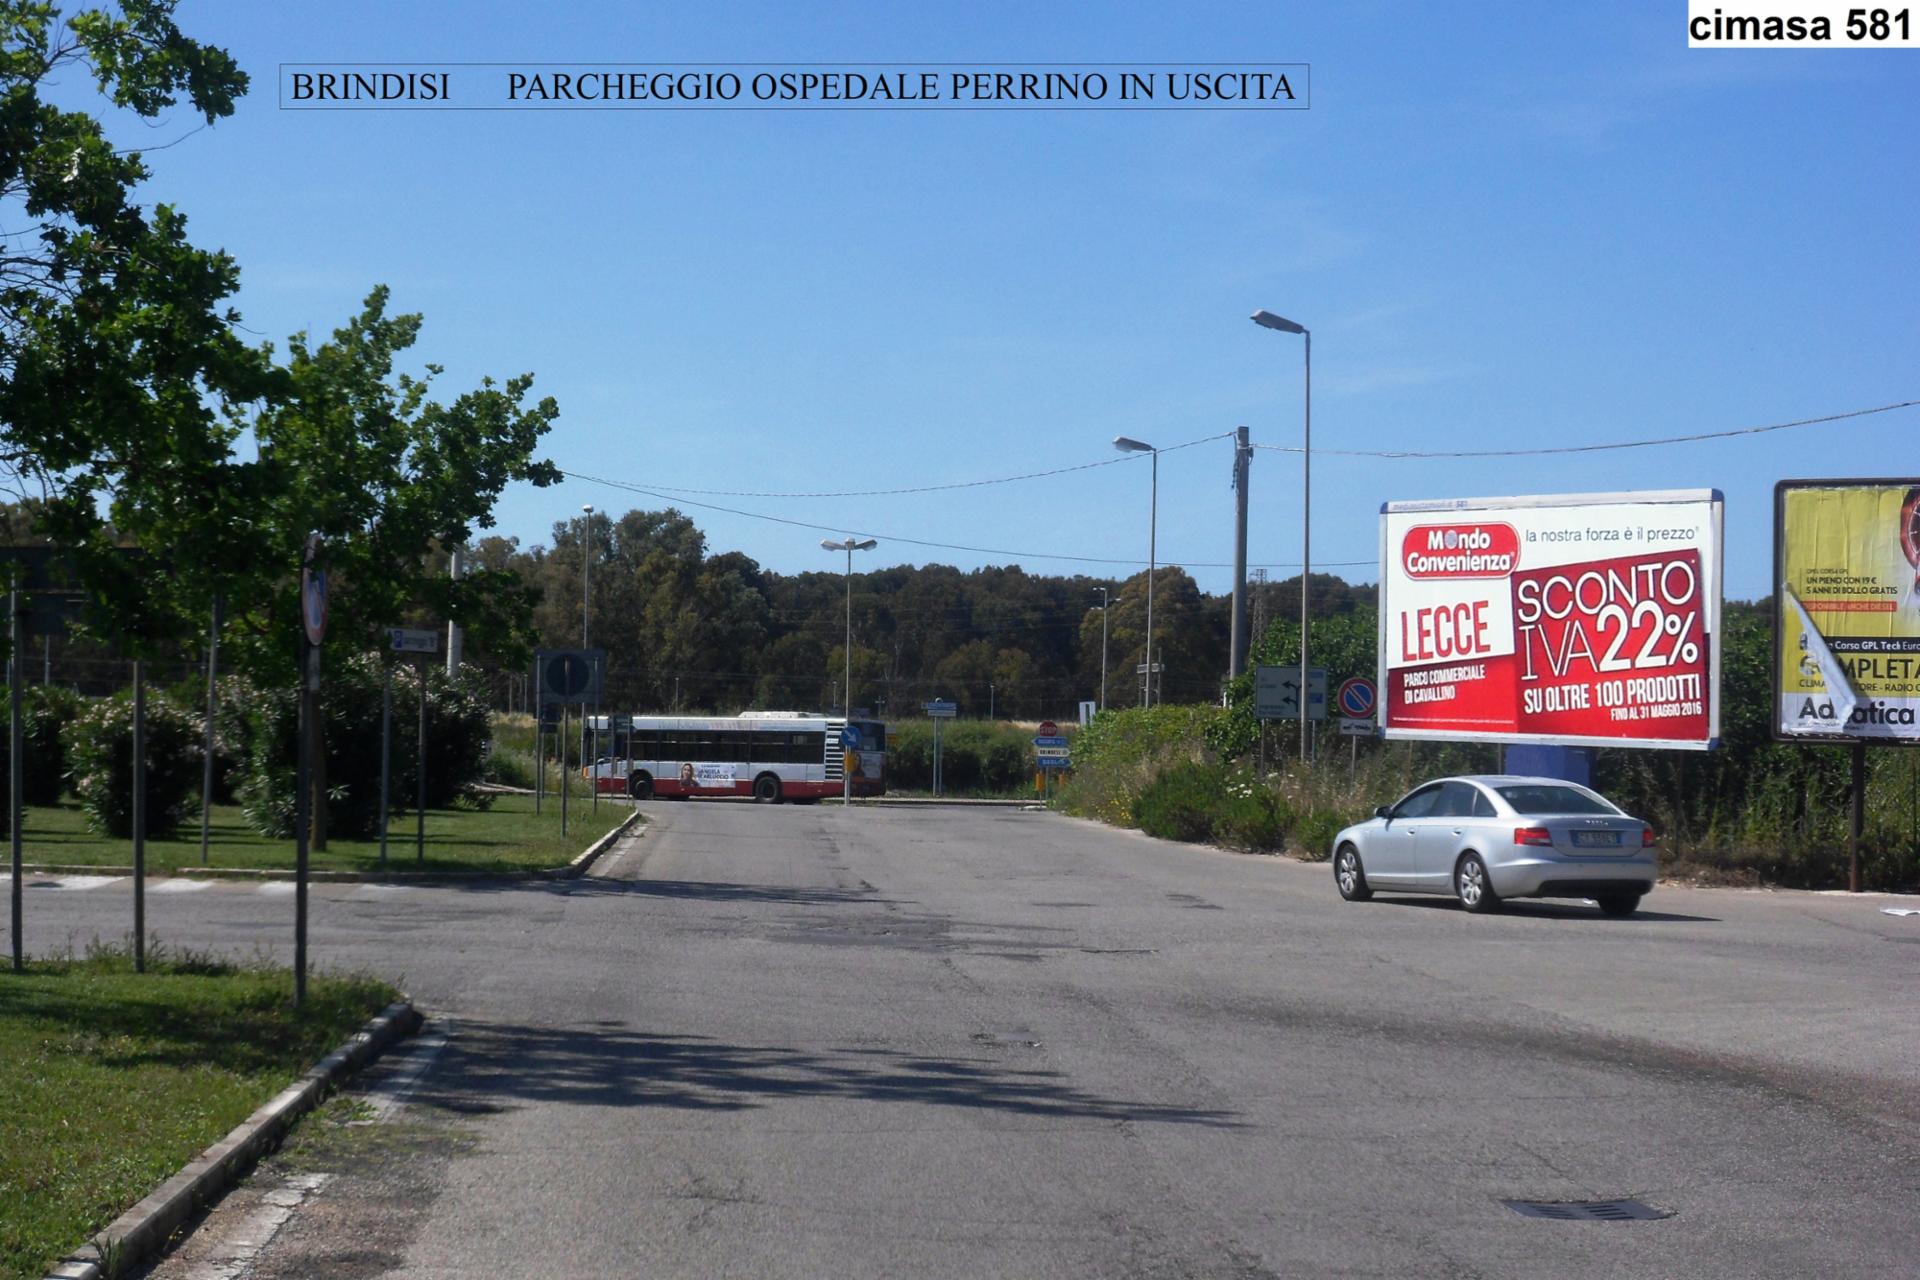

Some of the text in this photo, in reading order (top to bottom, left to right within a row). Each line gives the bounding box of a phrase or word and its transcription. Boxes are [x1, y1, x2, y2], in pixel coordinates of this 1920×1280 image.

[1427, 527, 1490, 550] Mondo
[1526, 526, 1695, 545] la nostra forza è il prezzo
[1407, 552, 1512, 573] Convenienza
[1518, 560, 1695, 623] SCONTO
[1401, 600, 1491, 662] LECCE
[1519, 600, 1698, 681] IVA 22%
[1835, 641, 1860, 650] Corsa
[1862, 641, 1879, 650] GPL
[1881, 641, 1901, 650] Tech
[1403, 664, 1486, 688] PARCO COMMERCIALE
[1404, 685, 1456, 705] DI CAVALLINO
[1524, 673, 1701, 714] SU OLTRE 100 PRODOTTI
[1885, 683, 1913, 692] RADIO
[1611, 701, 1702, 721] FINO AL 31 MAGGIO 2016
